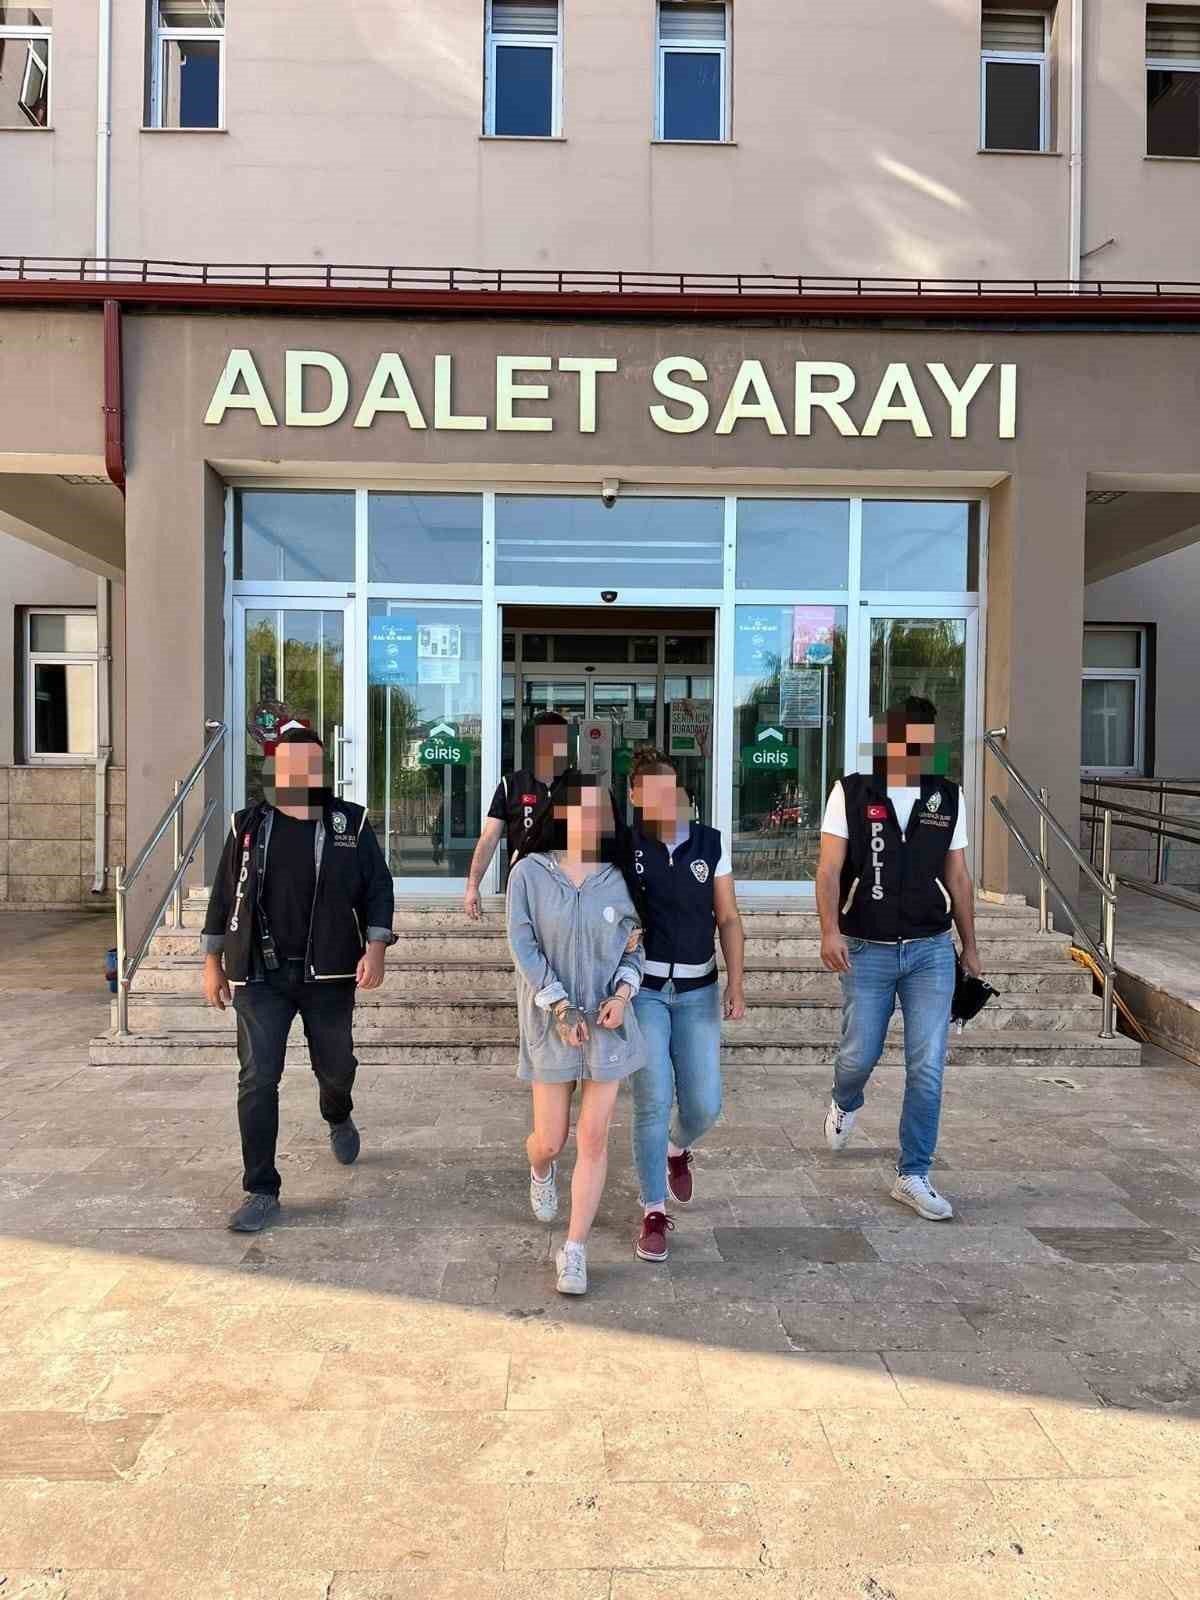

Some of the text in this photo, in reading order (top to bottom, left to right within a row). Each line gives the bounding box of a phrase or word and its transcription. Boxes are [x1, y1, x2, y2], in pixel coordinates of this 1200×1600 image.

[204, 349, 1018, 438] ADALET SARAYI
[424, 746, 461, 762] GİRİŞ
[752, 750, 789, 766] GİRİŞ
[523, 806, 534, 829] PO
[634, 849, 644, 874] PO
[871, 822, 885, 900] POLİS
[230, 851, 250, 932] POLİS
